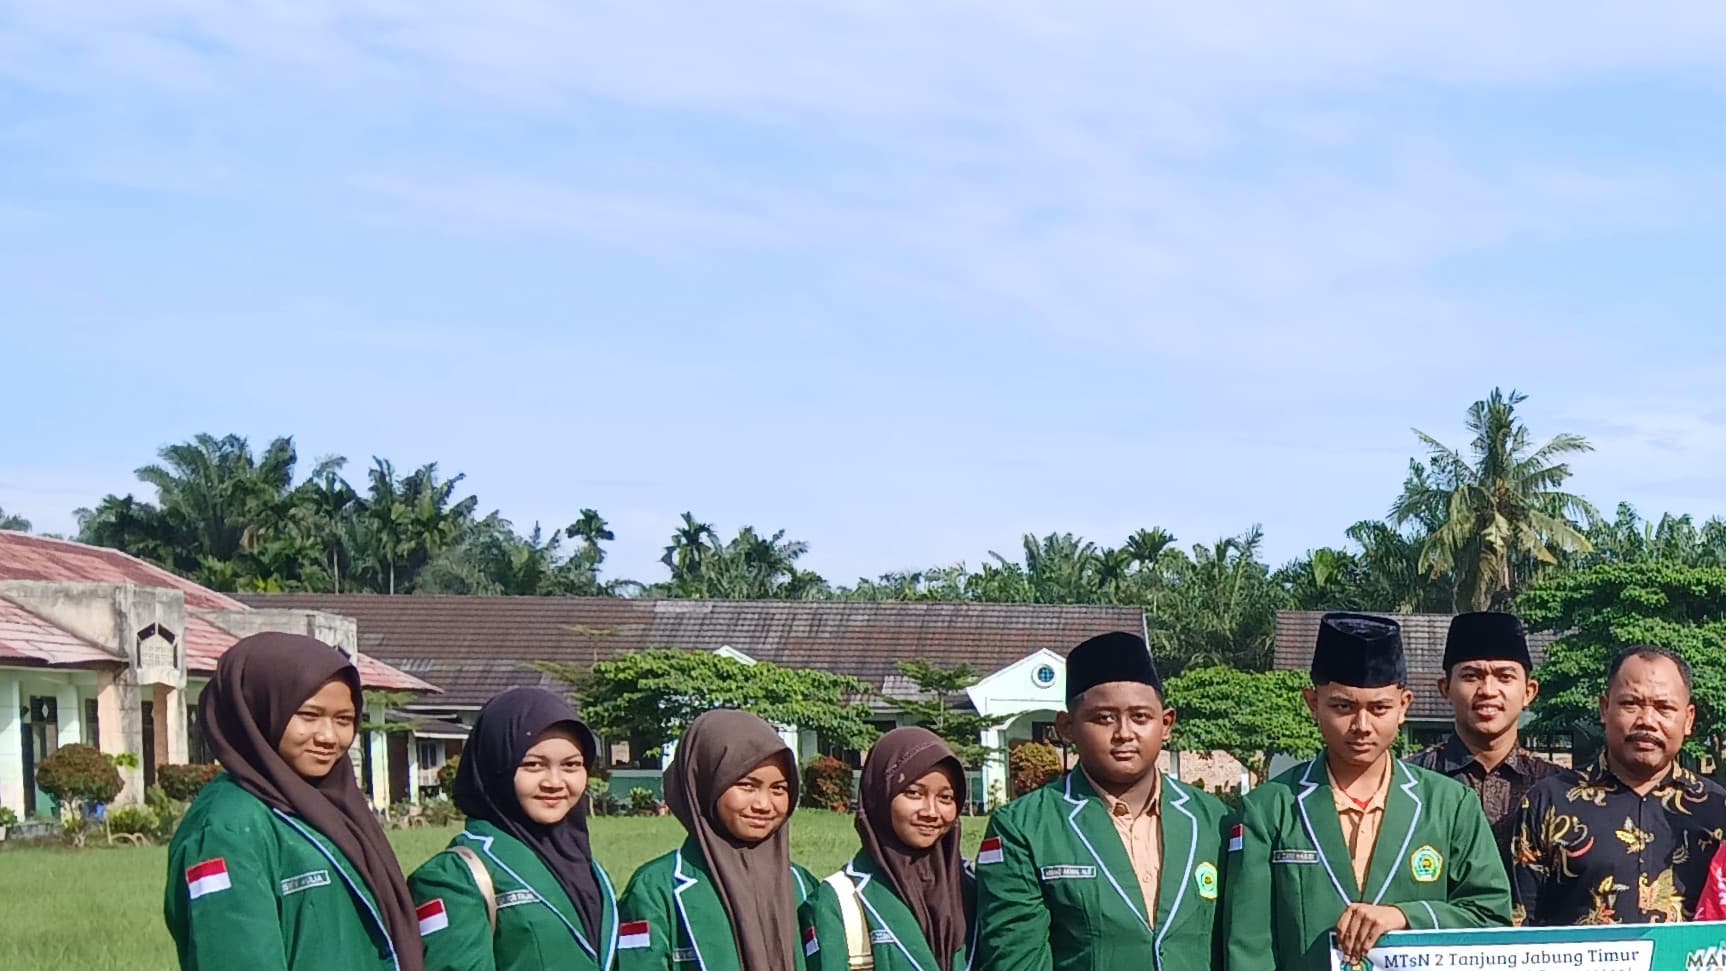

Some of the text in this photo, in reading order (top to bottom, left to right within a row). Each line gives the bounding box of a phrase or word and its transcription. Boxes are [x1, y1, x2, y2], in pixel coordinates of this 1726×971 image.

[1384, 955, 1429, 969] MTsN
[1450, 952, 1517, 970] Tanjung
[1521, 950, 1583, 968] Jabung
[1588, 948, 1640, 963] Timur
